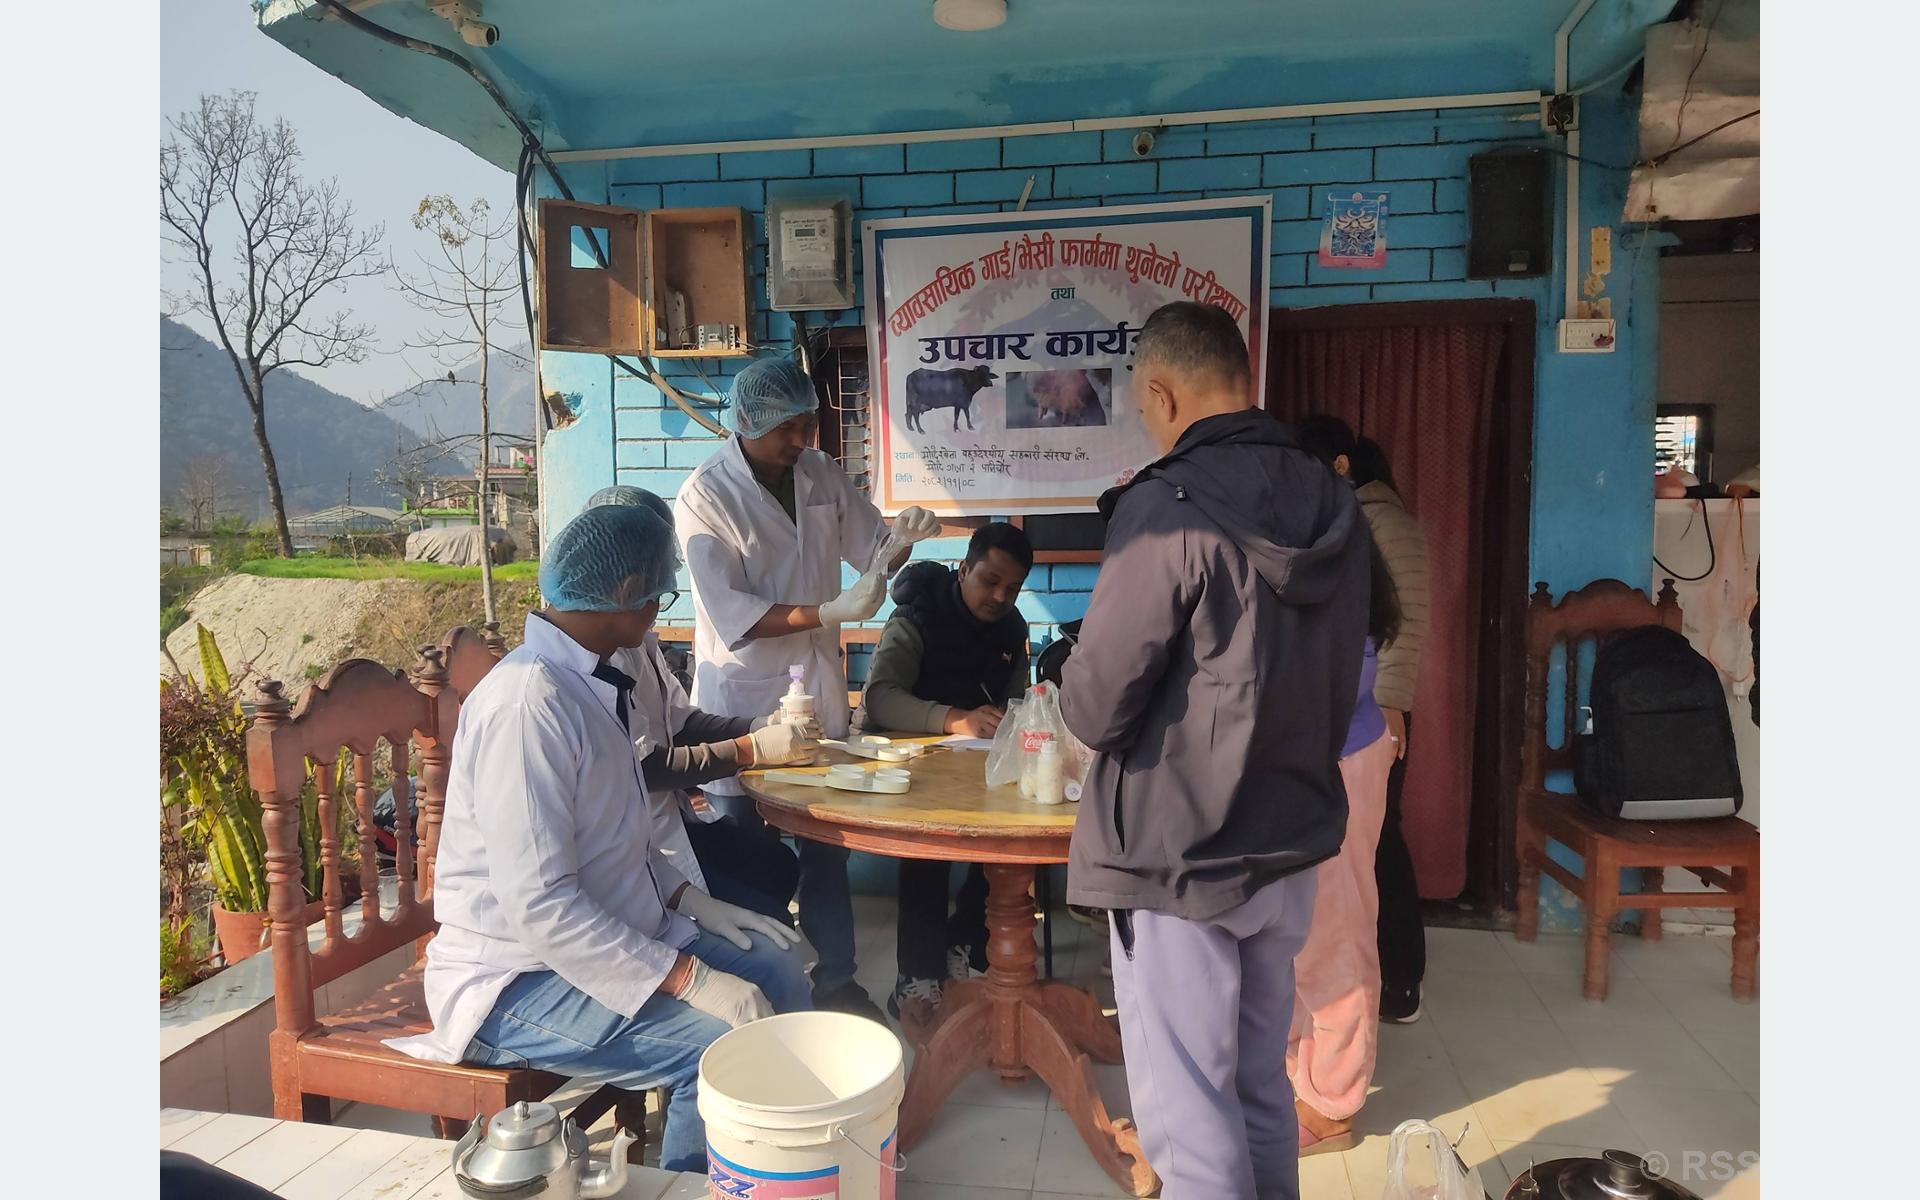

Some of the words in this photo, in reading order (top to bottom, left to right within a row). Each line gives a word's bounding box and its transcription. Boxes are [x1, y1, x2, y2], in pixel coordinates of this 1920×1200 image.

[888, 261, 976, 336] व्यावसायिक
[979, 232, 1055, 280] गाई/भैसी
[1060, 233, 1122, 271] फार्ममा
[1125, 242, 1181, 289] थुनेलो
[1051, 287, 1075, 300] तथा
[918, 333, 1034, 363] उपचार
[1046, 321, 1143, 371] कार्य
